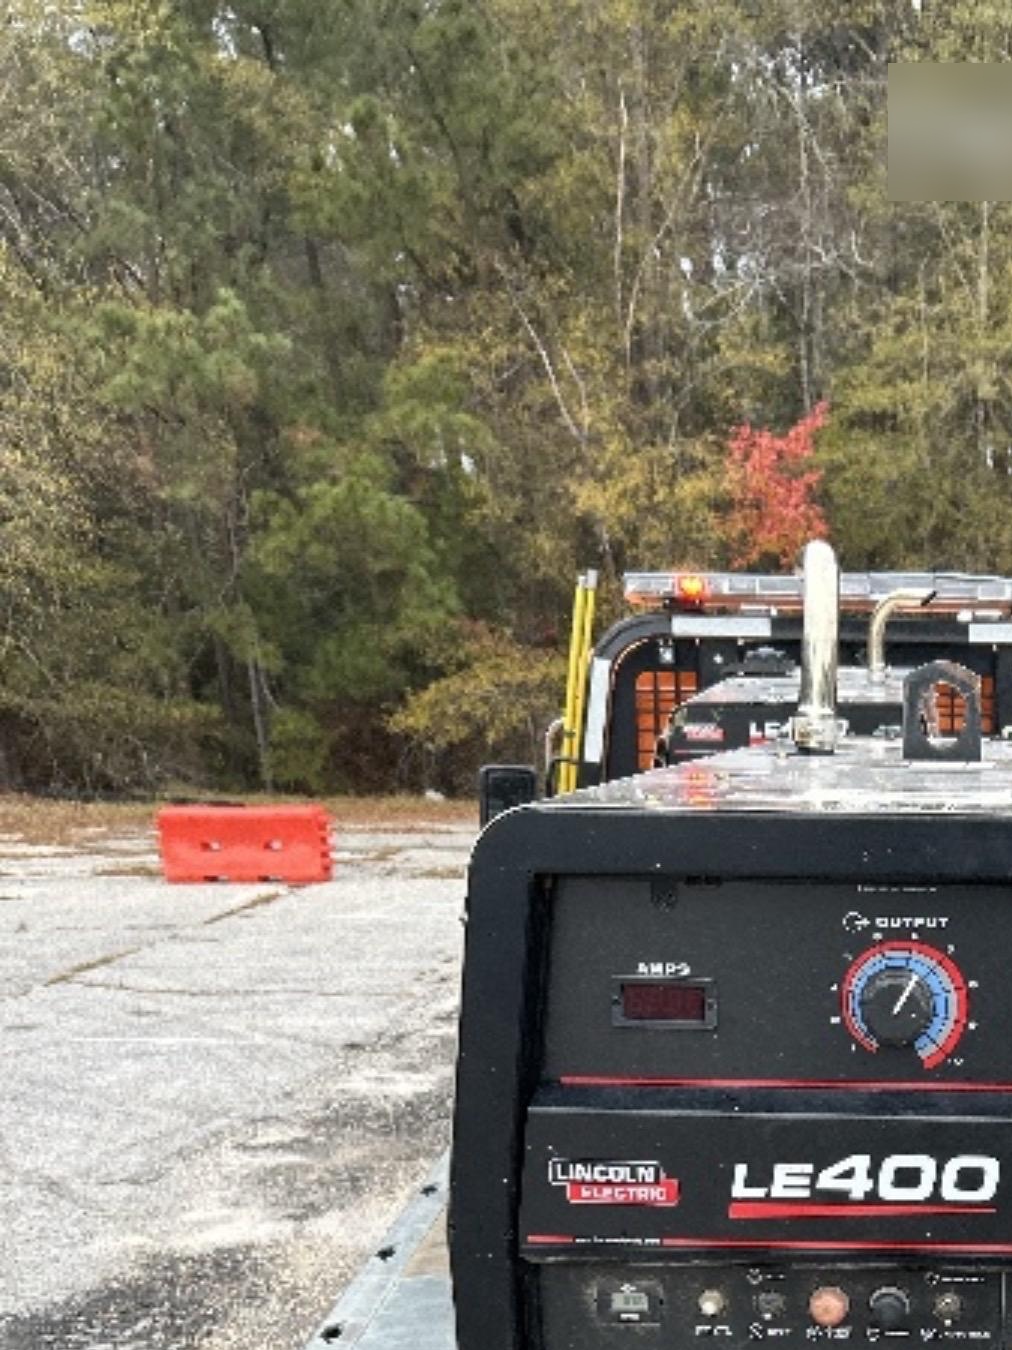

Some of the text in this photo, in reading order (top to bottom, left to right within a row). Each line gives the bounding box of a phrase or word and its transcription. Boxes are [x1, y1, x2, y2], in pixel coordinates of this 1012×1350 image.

[874, 916, 950, 928] OUTPUT
[636, 961, 692, 977] AMPS
[556, 1162, 656, 1184] LINCOLN
[731, 1153, 1000, 1202] LE400
[580, 1186, 668, 1202] ELECTRIC
